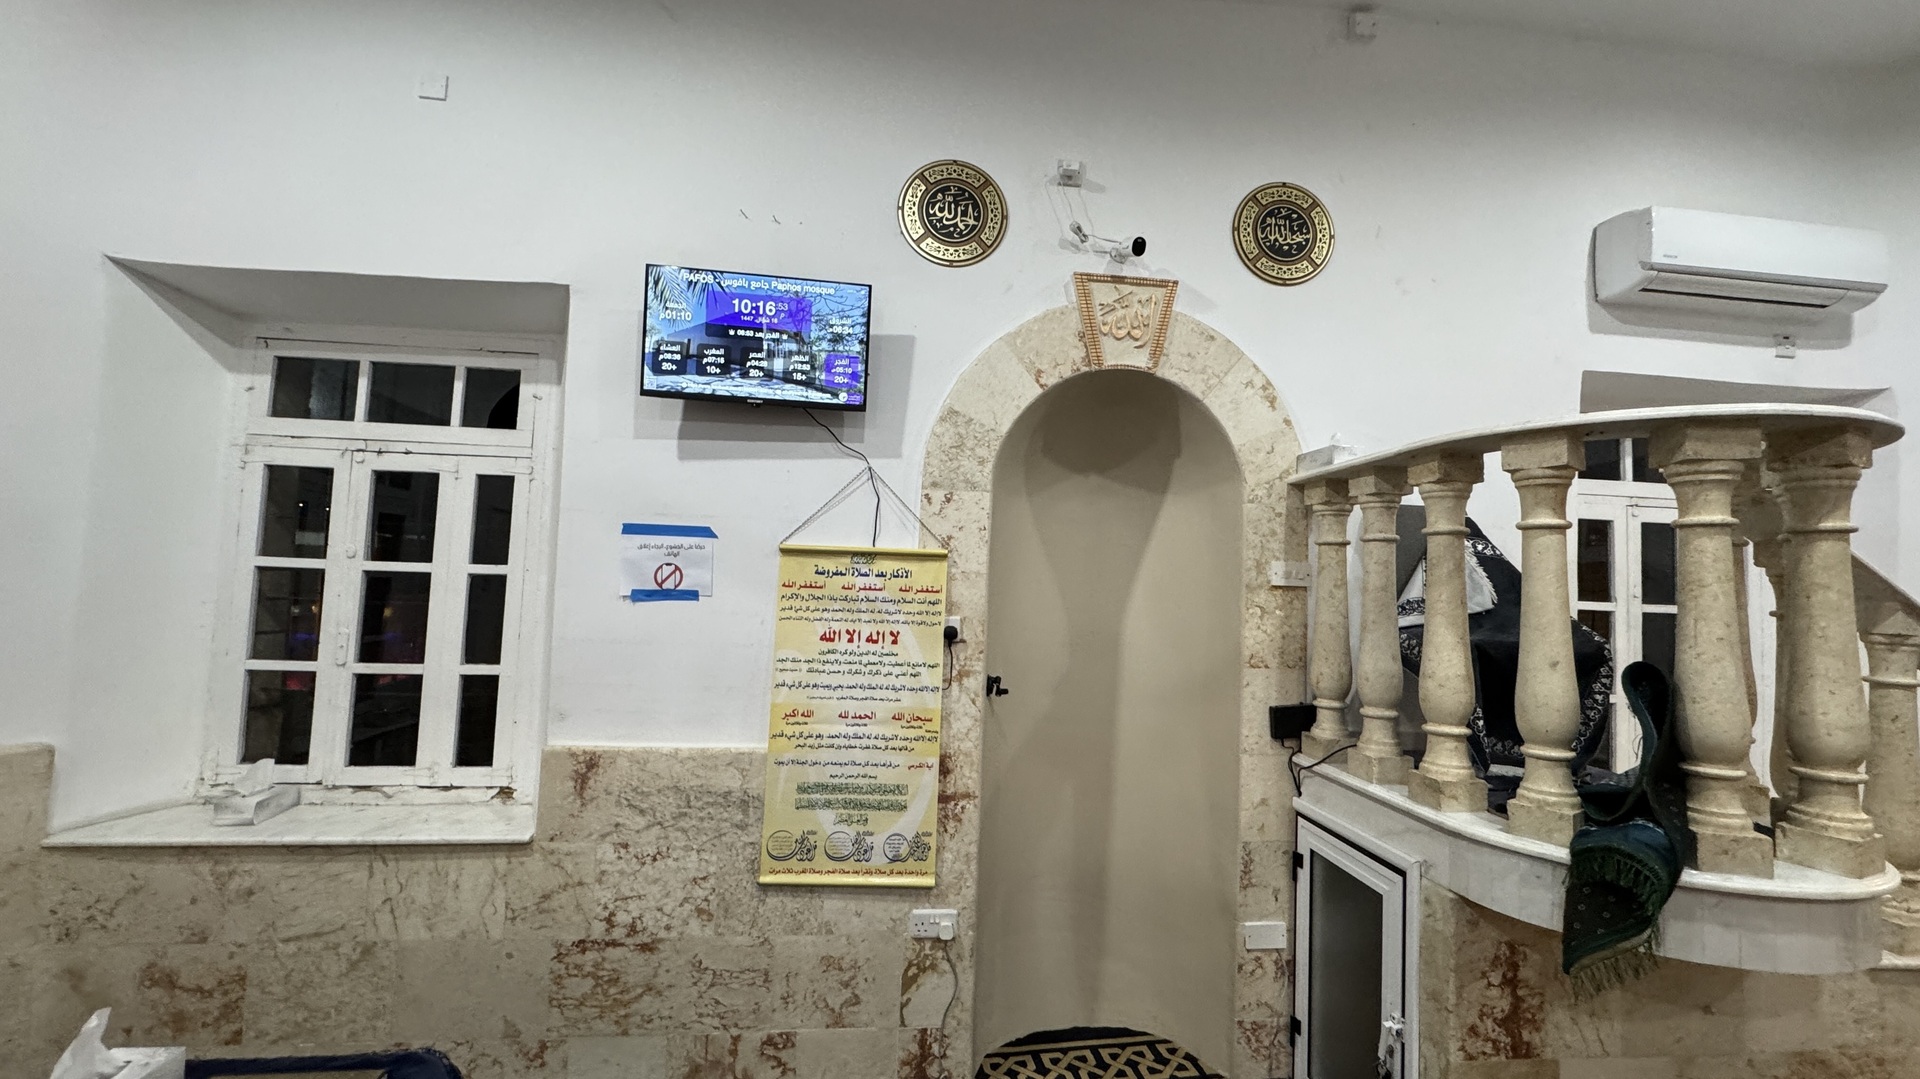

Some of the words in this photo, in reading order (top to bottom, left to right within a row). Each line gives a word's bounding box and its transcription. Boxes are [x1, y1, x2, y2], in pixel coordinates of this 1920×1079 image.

[683, 272, 714, 284] PAFOS
[772, 281, 801, 293] Paphos
[803, 285, 835, 296] mosque
[732, 298, 776, 316] 10:16
[814, 564, 850, 578] المفروضة
[851, 566, 874, 578] الصلاة
[875, 569, 887, 582] بعد
[888, 567, 913, 581] الأذكار
[781, 578, 796, 588] الله
[797, 580, 826, 590] أستغفر
[841, 581, 856, 591] الله
[856, 582, 886, 593] أستغفر
[898, 583, 913, 592] الله
[914, 584, 943, 595] أستغفر
[804, 593, 826, 602] الجلال
[838, 594, 859, 604] تباركت
[859, 595, 879, 604] السلام
[880, 596, 896, 605] ومنك
[896, 596, 915, 606] السلام
[916, 596, 926, 604] أنت
[927, 598, 942, 606] اللهم
[819, 624, 842, 643] الله
[845, 628, 861, 649] إلا
[889, 630, 900, 645] لا
[865, 630, 886, 650] إله
[800, 709, 814, 718] الله
[838, 710, 849, 719] لله
[851, 710, 876, 720] الحمد
[892, 712, 905, 721] الله
[906, 712, 933, 726] سبحان
